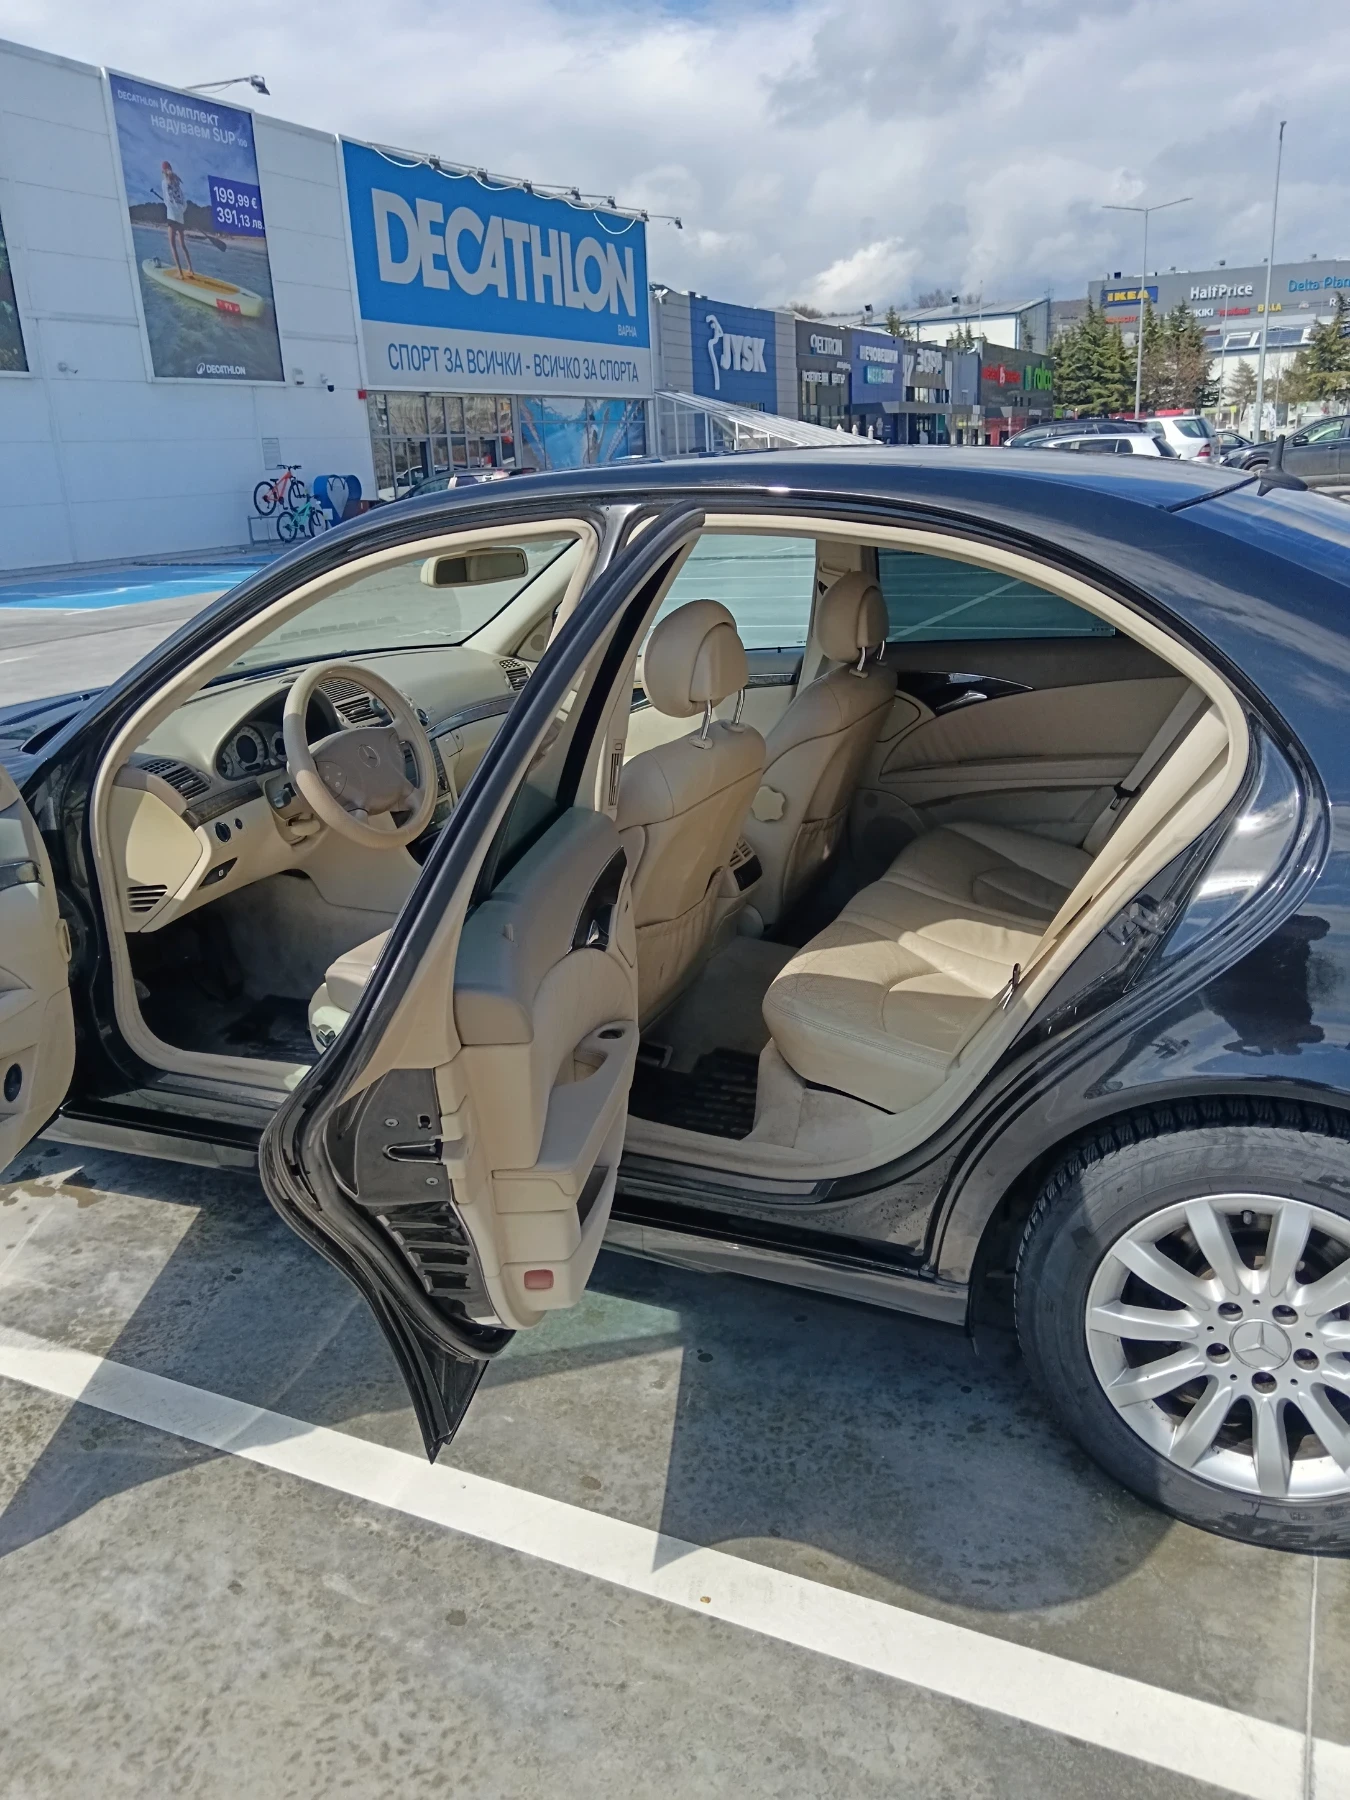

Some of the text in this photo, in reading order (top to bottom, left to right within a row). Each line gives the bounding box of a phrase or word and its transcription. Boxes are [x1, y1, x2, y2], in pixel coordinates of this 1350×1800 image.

[117, 89, 219, 127] DECATHLON Комплект
[150, 114, 248, 147] надуваем SUP 100
[213, 186, 258, 209] 199,99 €
[216, 207, 265, 230] 391,13 лв.
[371, 188, 637, 317] DECATHLON
[1107, 289, 1149, 302] IKEA
[1190, 283, 1254, 300] HalfPrice
[1288, 278, 1320, 292] Delta
[617, 324, 638, 338] ВАРНА
[388, 343, 440, 372] СПОРТ
[444, 347, 465, 374] ЗА
[466, 348, 523, 376] ВСИЧКИ
[533, 353, 581, 379] ВСИЧКО
[583, 358, 598, 380] ЗА
[599, 359, 640, 383] СПОРТА
[720, 333, 767, 373] JYSK
[205, 364, 245, 375] DECATHLON
